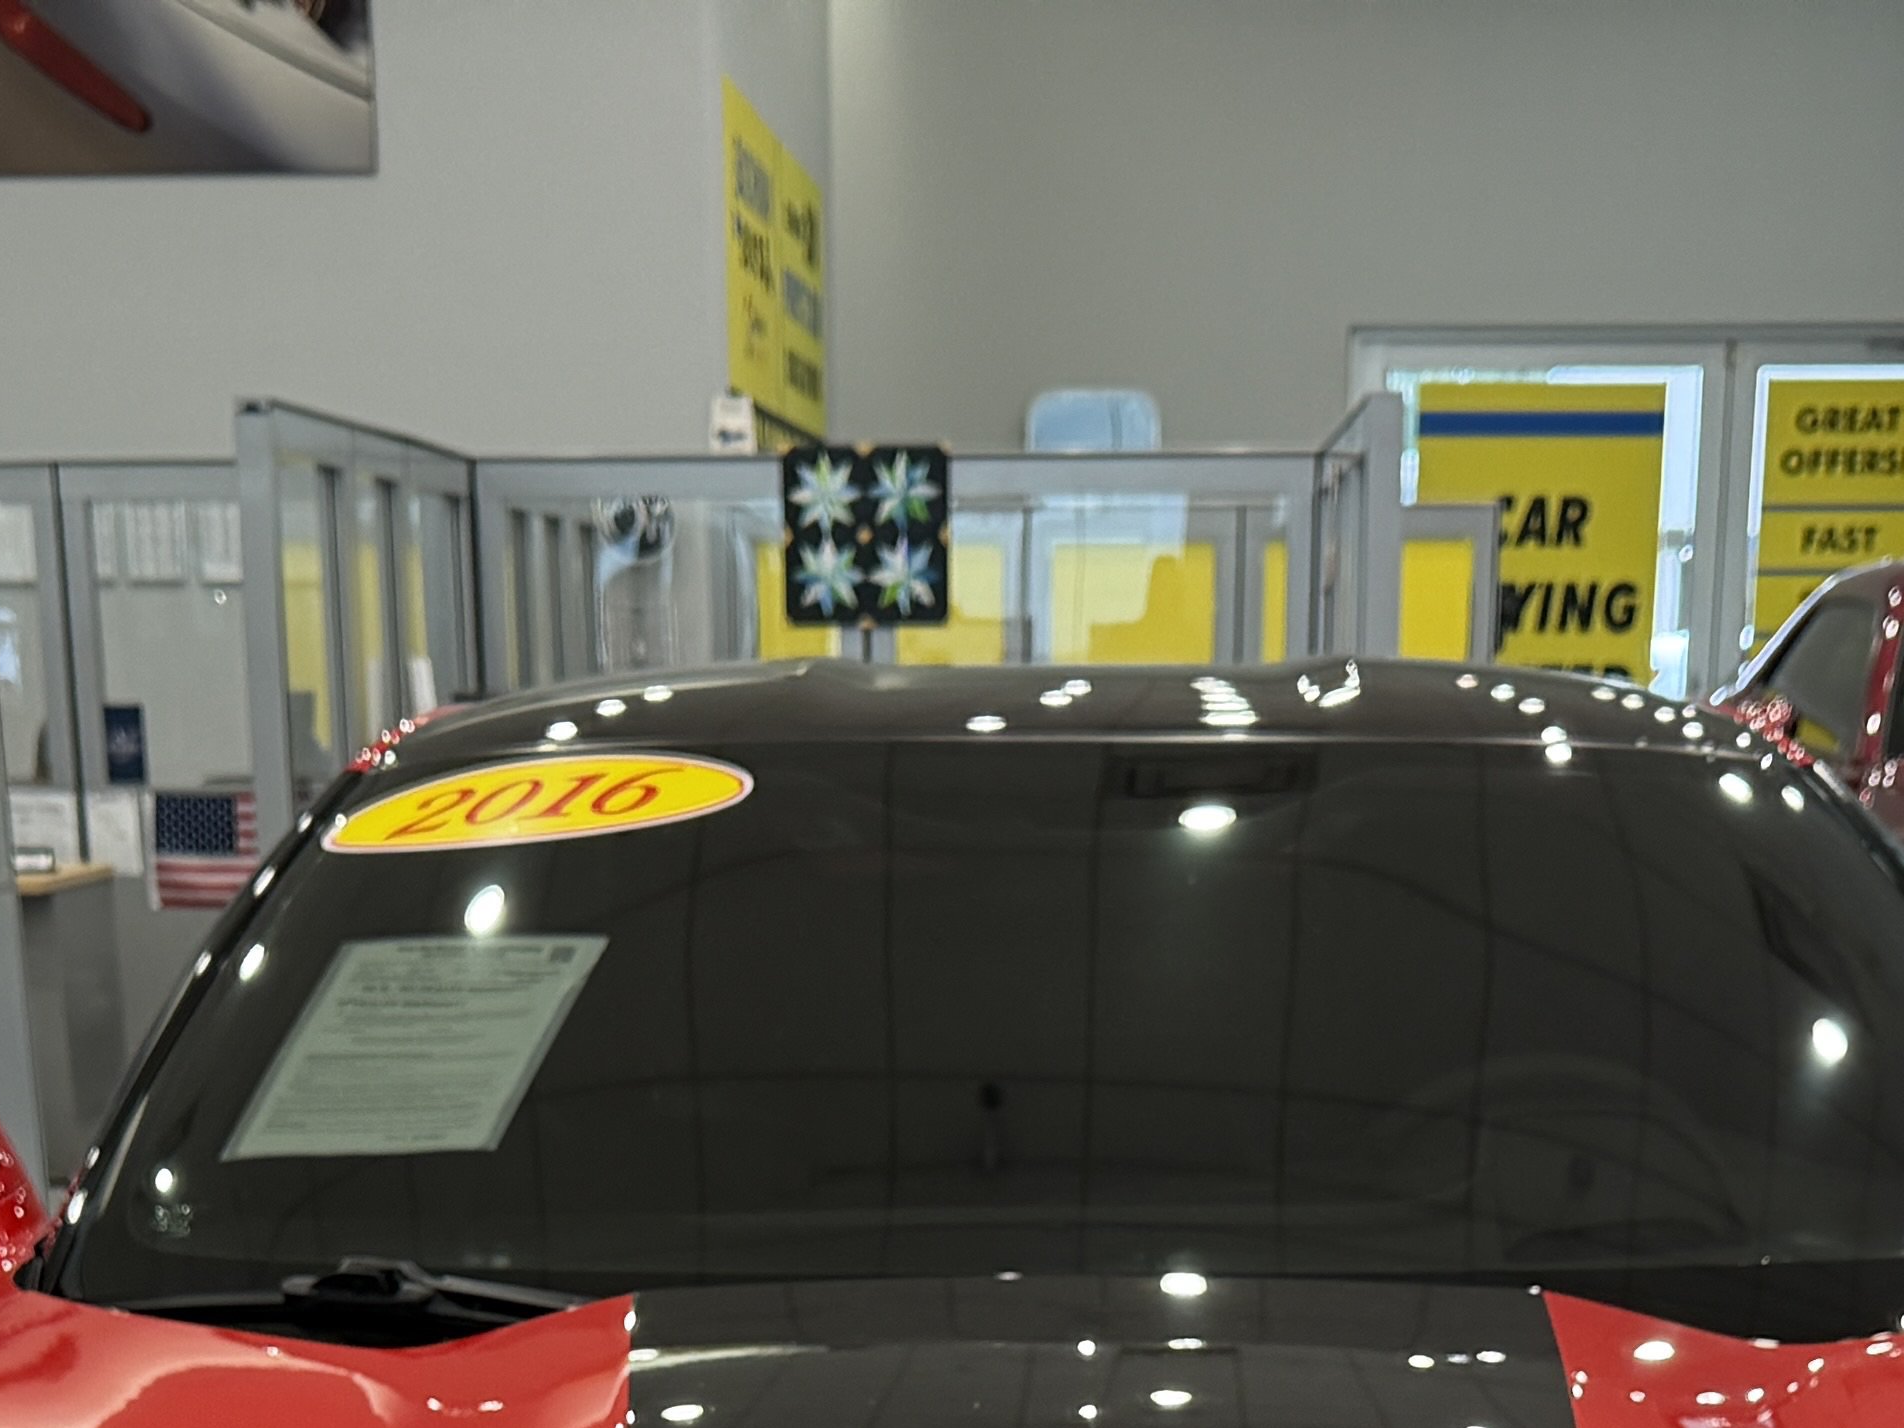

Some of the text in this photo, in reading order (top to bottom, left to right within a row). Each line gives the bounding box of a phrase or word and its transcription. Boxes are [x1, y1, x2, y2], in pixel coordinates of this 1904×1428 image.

[1796, 405, 1902, 434] GREAT
[1800, 526, 1878, 552] FAST
[381, 767, 688, 842] 2016
